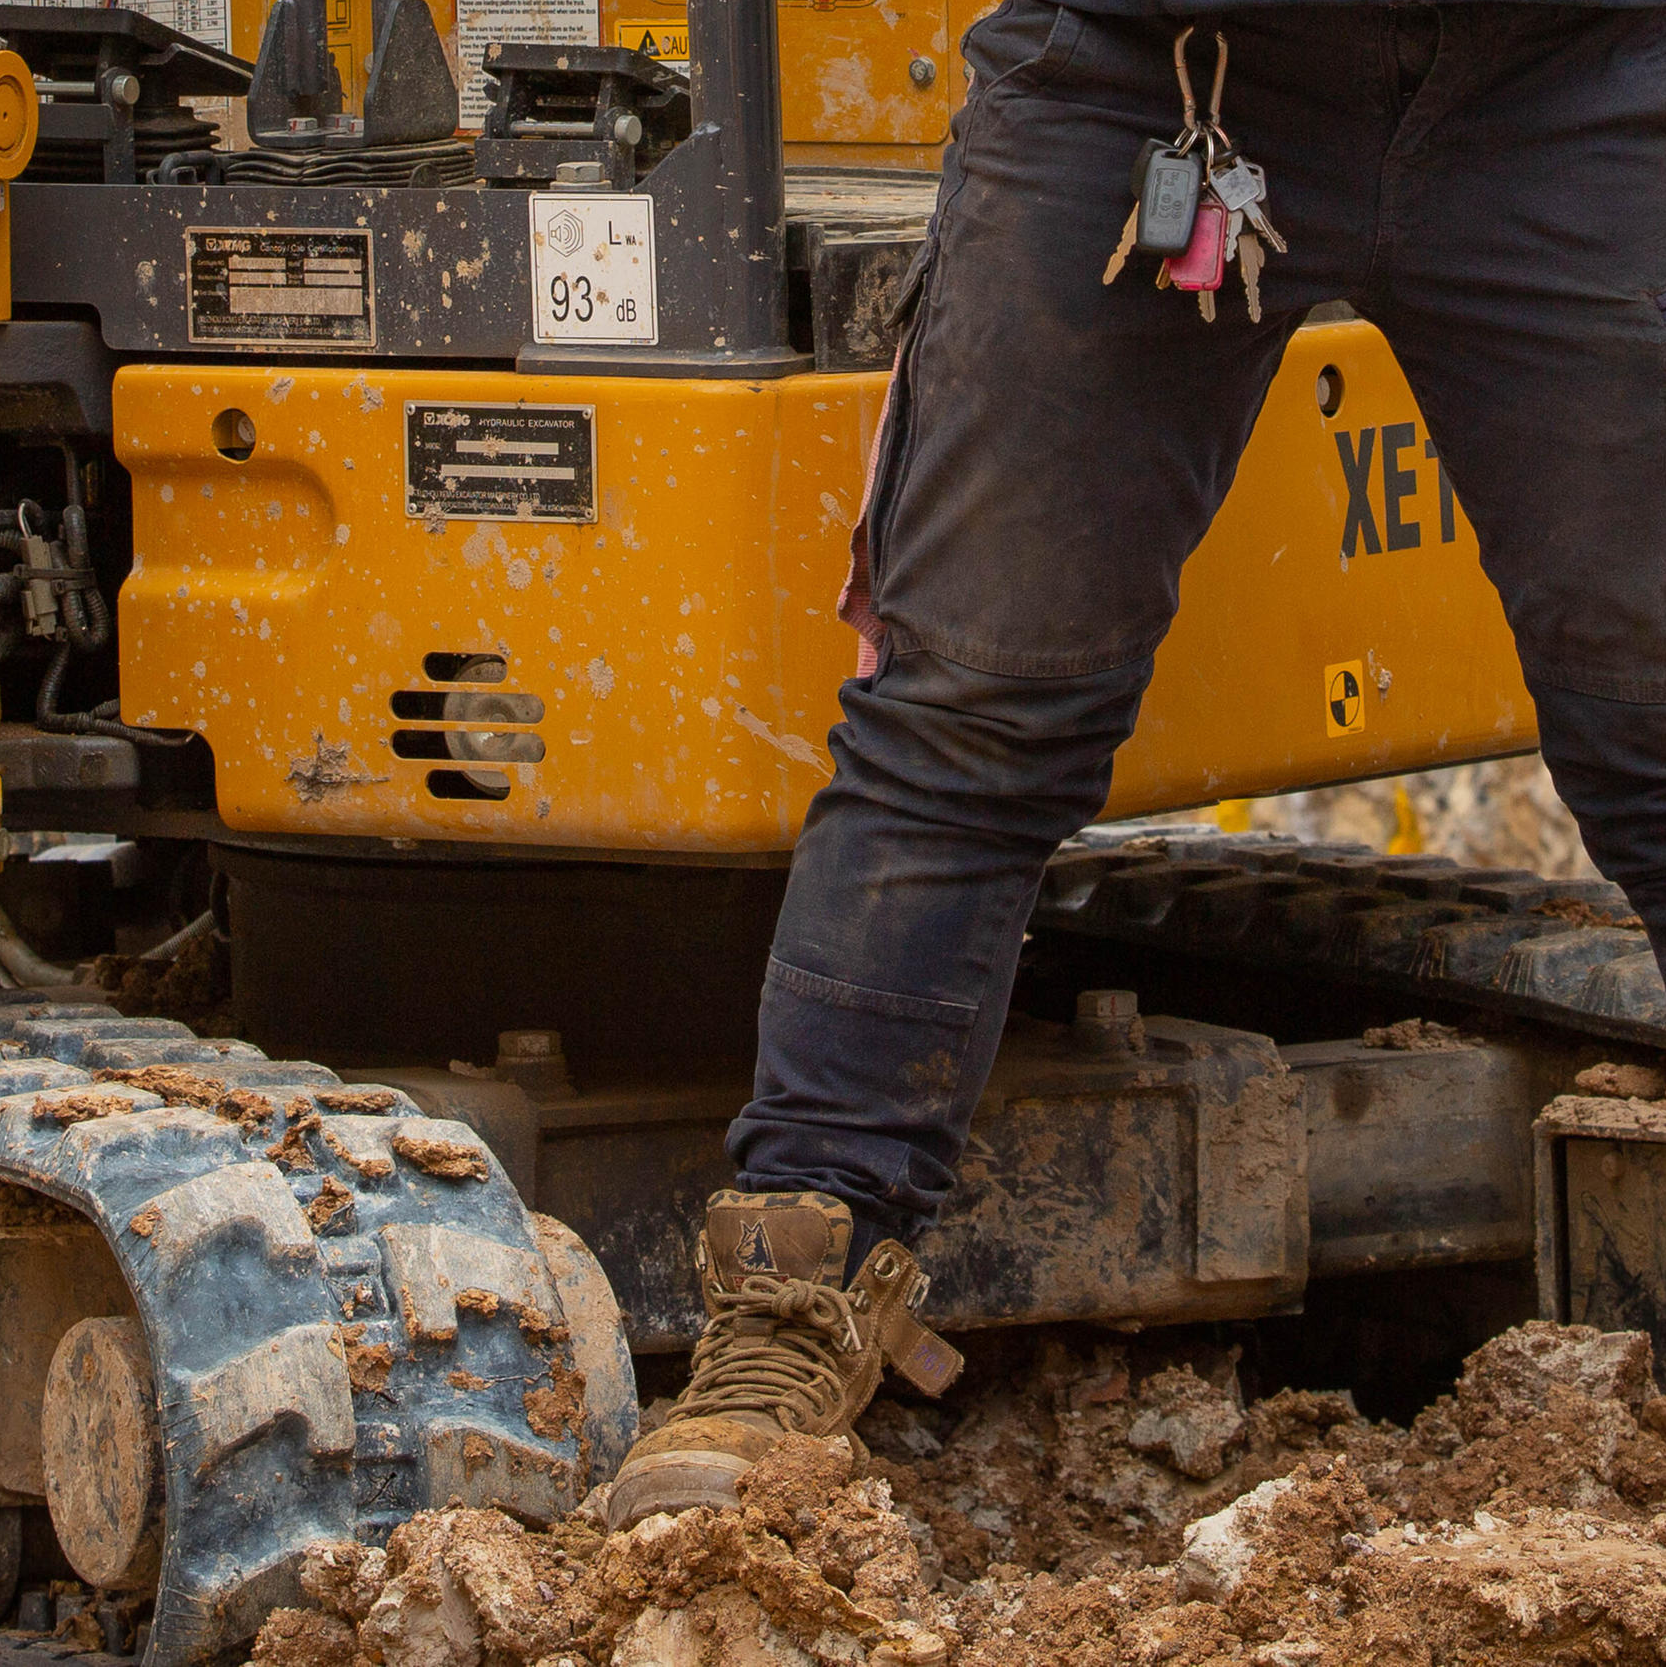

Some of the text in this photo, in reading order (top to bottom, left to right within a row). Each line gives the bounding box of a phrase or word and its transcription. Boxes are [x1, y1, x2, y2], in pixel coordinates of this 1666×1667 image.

[608, 221, 637, 246] L WA
[550, 276, 637, 322] 93 dB
[479, 419, 525, 427] HYDRAULIC
[528, 420, 575, 429] EXCAVATOR
